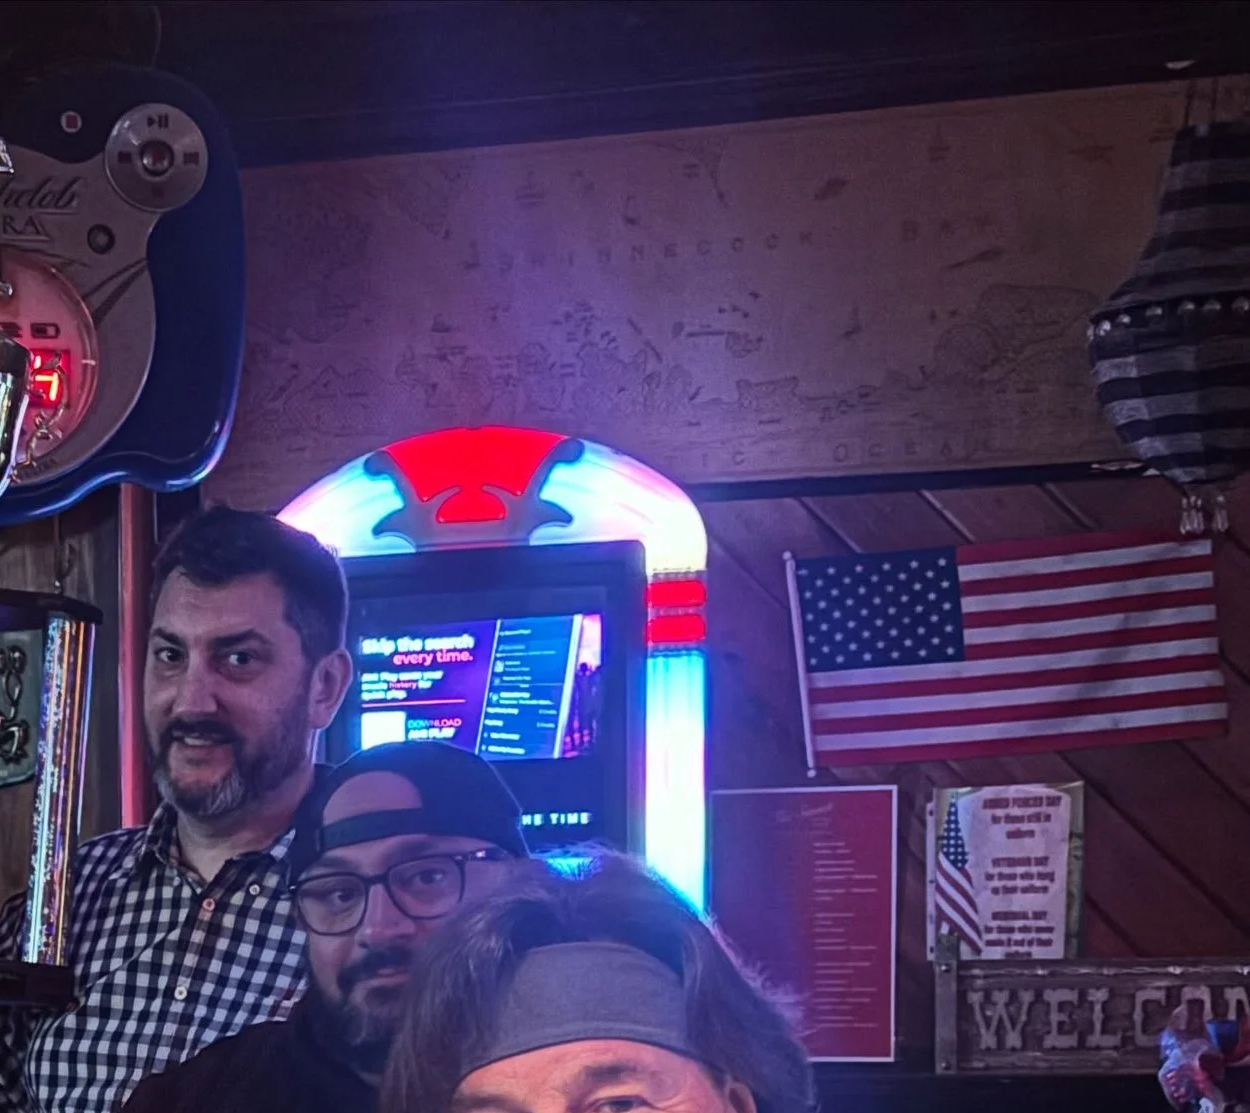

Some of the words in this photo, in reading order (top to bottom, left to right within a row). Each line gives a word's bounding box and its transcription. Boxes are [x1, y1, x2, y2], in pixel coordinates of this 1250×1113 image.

[393, 653, 433, 666] every
[436, 649, 474, 663] time.
[550, 812, 591, 825] TIME
